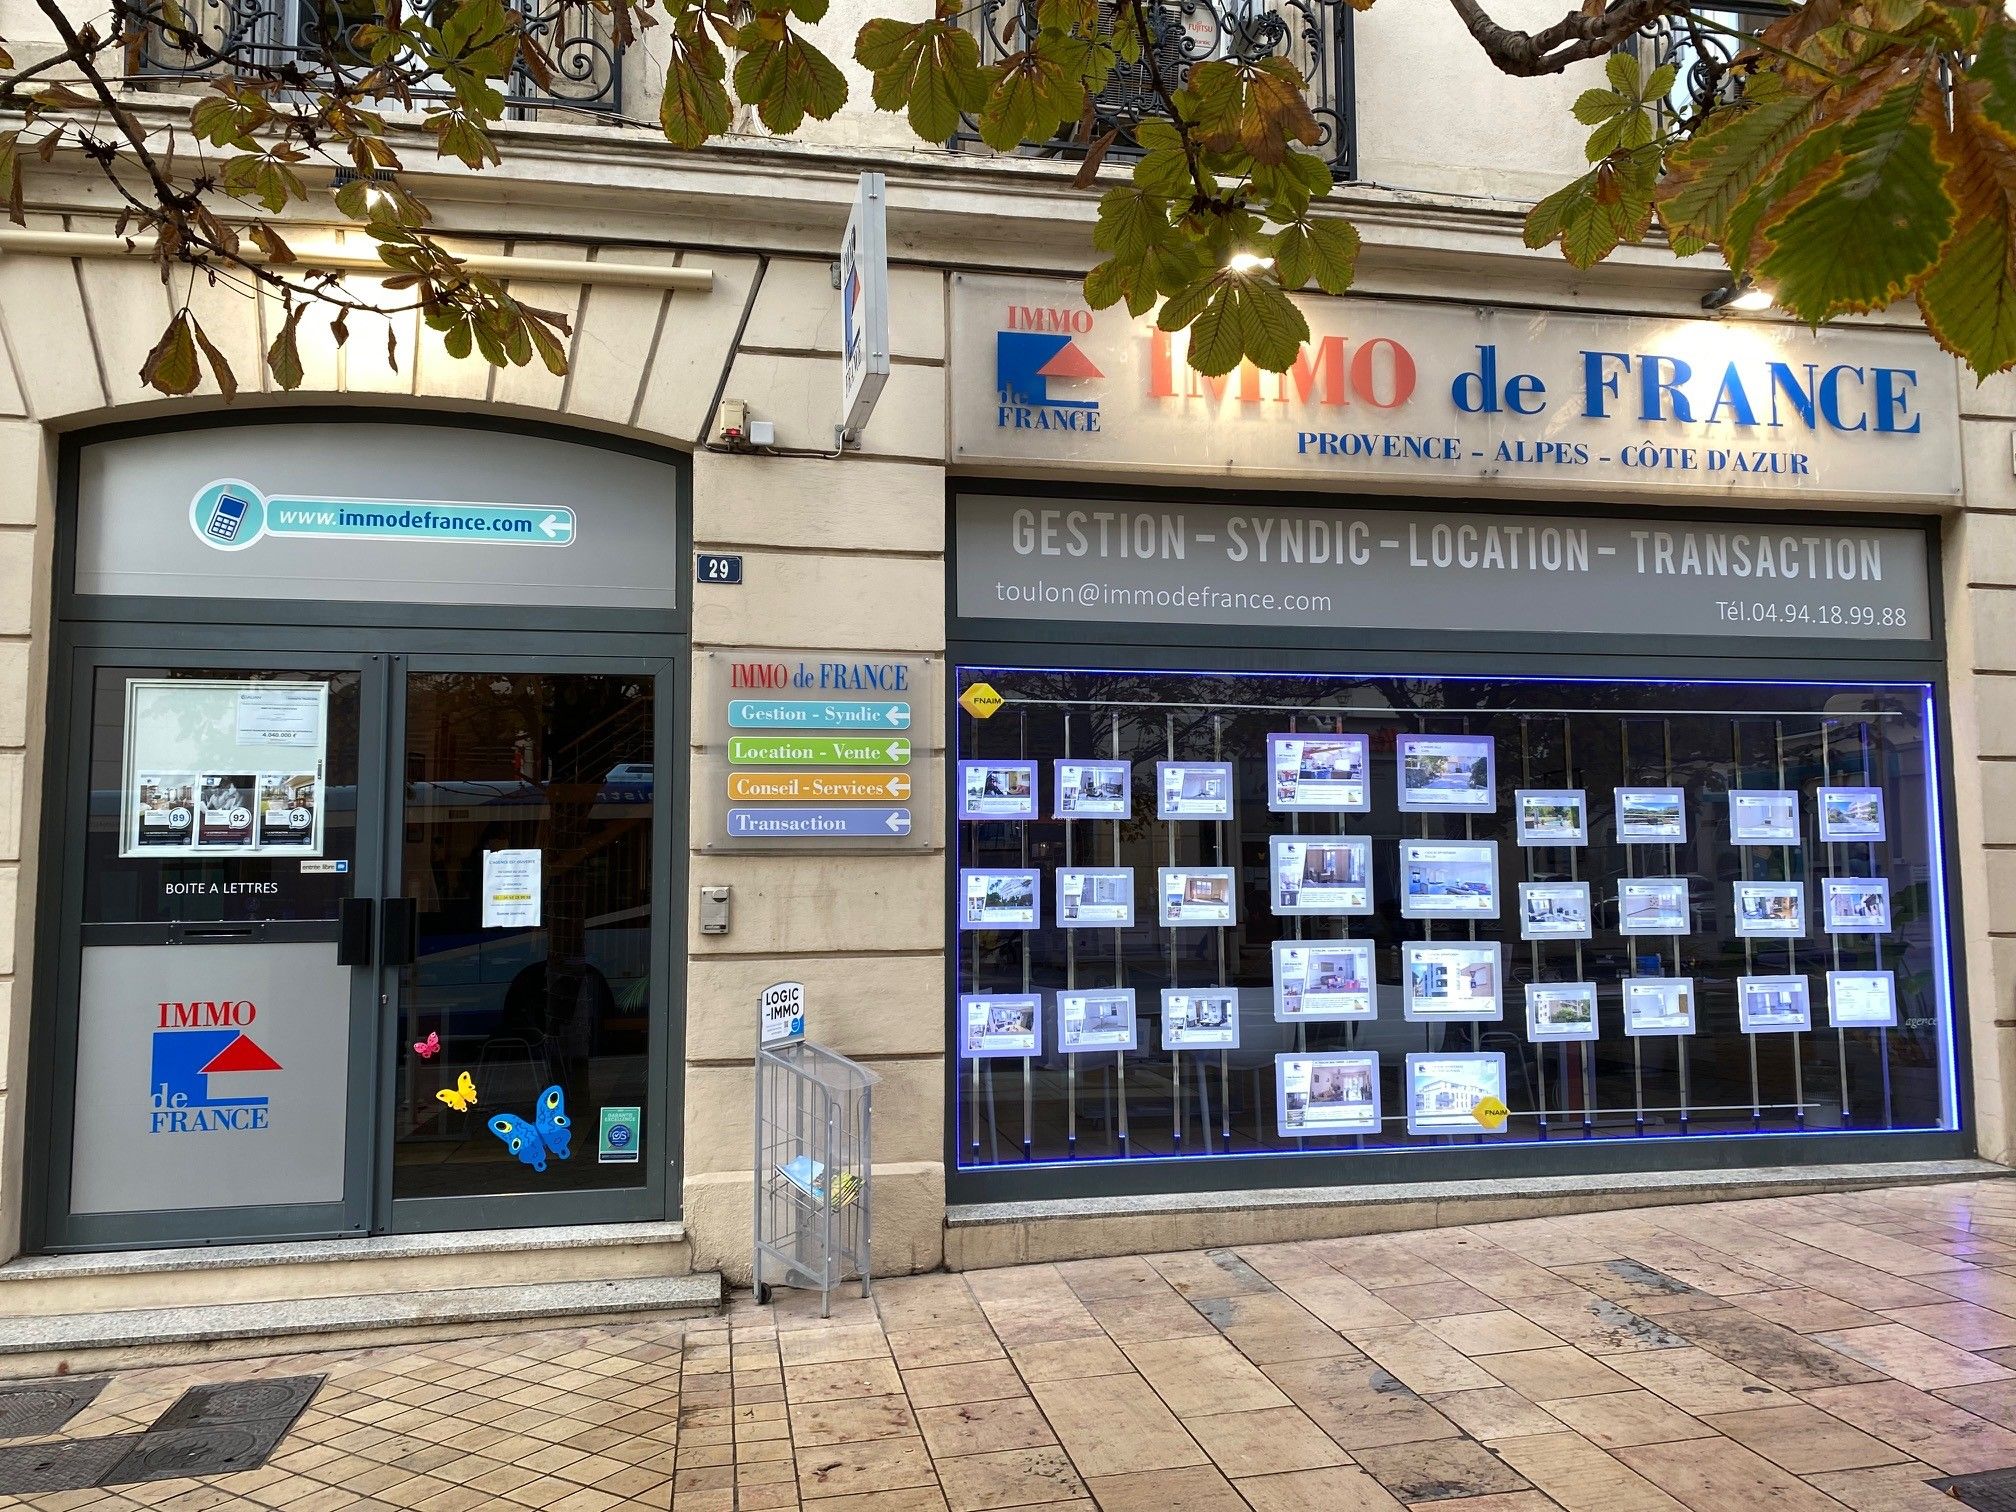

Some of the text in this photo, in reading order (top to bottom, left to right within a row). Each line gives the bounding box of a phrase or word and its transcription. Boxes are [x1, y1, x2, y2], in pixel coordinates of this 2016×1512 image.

[1188, 21, 1213, 32] FUJITSU
[1007, 306, 1093, 334] IMMO
[999, 382, 1029, 405] de
[1451, 344, 1547, 415] de
[1579, 348, 1921, 435] FRANCE
[997, 406, 1101, 432] FRANCE
[1297, 432, 1461, 460] PROVENCE
[1495, 440, 1589, 465] ALPES
[1621, 440, 1698, 470] CÔTE
[1708, 449, 1810, 476] D'AZUR
[279, 508, 533, 532] www.immodefrance.com
[1012, 508, 1185, 560] GESTION
[1226, 517, 1371, 566] SYNDIC
[1408, 522, 1588, 572] LOCATION
[1631, 530, 1883, 581] TRANSACTION
[709, 559, 729, 578] 29
[996, 581, 1332, 612] toulon@immodefrance.com
[1716, 600, 1907, 627] Tél.04.94.18.99.88
[730, 662, 908, 691] IMMO de FRANCE
[741, 704, 806, 721] Gestion
[825, 706, 881, 725] Syndic
[734, 742, 813, 760] Location
[833, 743, 880, 760] Vente
[737, 778, 799, 796] Conseil
[812, 779, 883, 796] Services
[172, 814, 185, 822] 89
[233, 814, 245, 822] 92
[292, 814, 304, 822] 93
[736, 814, 846, 831] Transaction
[165, 882, 278, 894] BOITE A LETTRES
[766, 987, 799, 1006] LOGIC
[157, 1000, 257, 1028] IMMO
[151, 1082, 188, 1109] de
[149, 1107, 269, 1134] FRANCE
